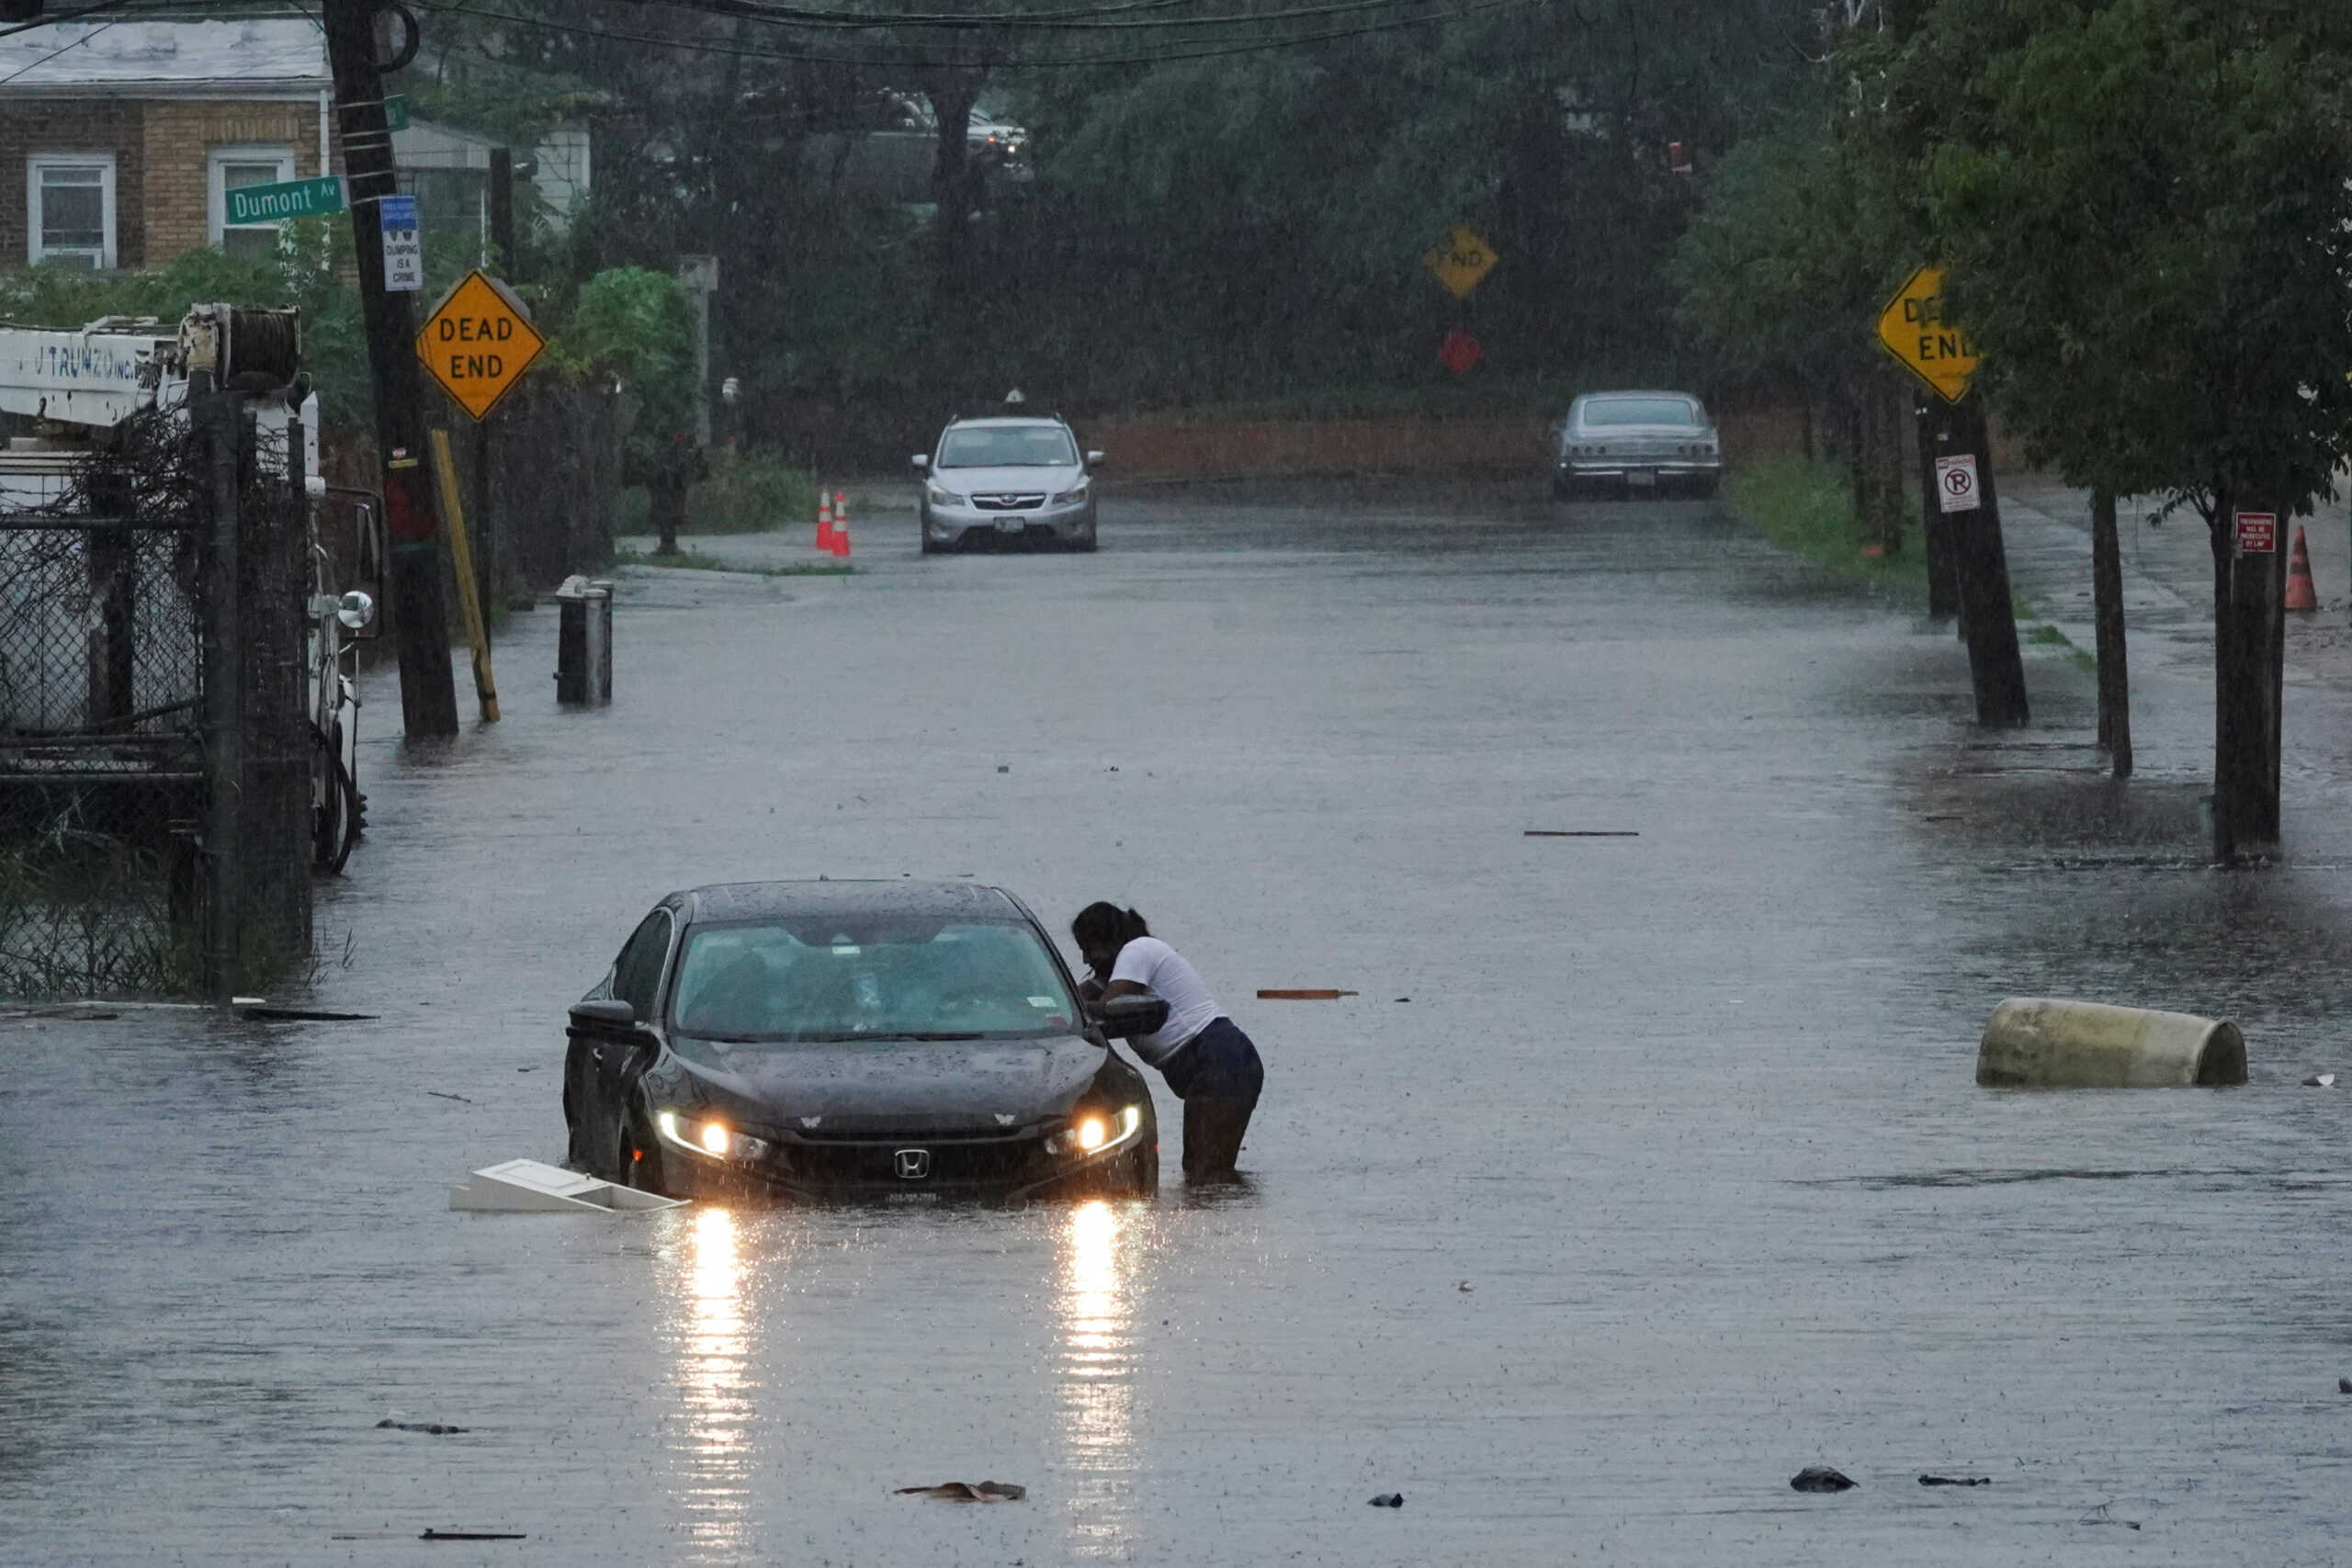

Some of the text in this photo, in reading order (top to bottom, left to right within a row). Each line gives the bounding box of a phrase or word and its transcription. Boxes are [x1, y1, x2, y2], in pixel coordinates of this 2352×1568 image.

[235, 183, 335, 218] Dumont Av
[386, 244, 419, 255] DUMPING
[393, 273, 415, 283] CRIME
[440, 318, 513, 341] DEAD
[451, 355, 503, 378] END
